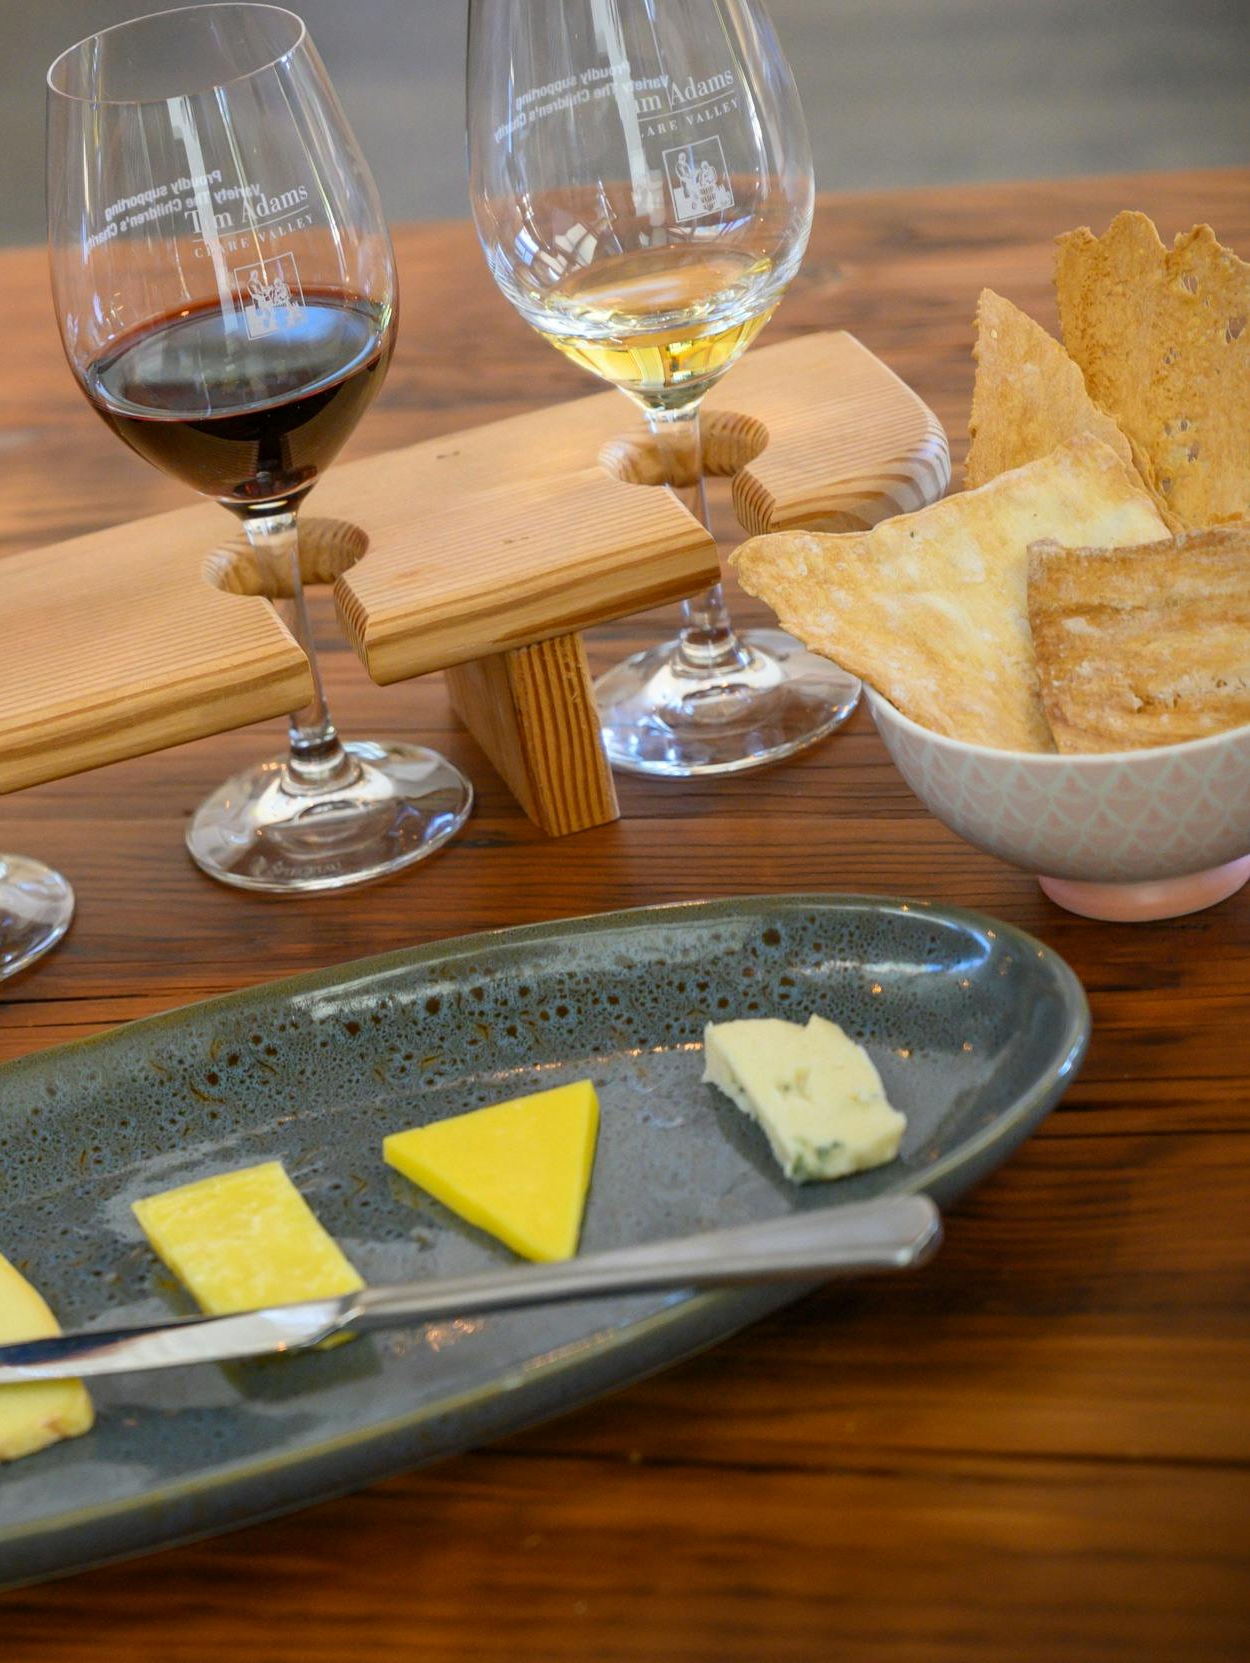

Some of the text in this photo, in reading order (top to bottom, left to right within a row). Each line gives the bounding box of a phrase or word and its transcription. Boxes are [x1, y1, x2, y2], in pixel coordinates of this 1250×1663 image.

[669, 69, 734, 107] Adams
[686, 97, 738, 126] VALLEY
[241, 185, 308, 223] Adams
[259, 214, 313, 243] VALLEY
